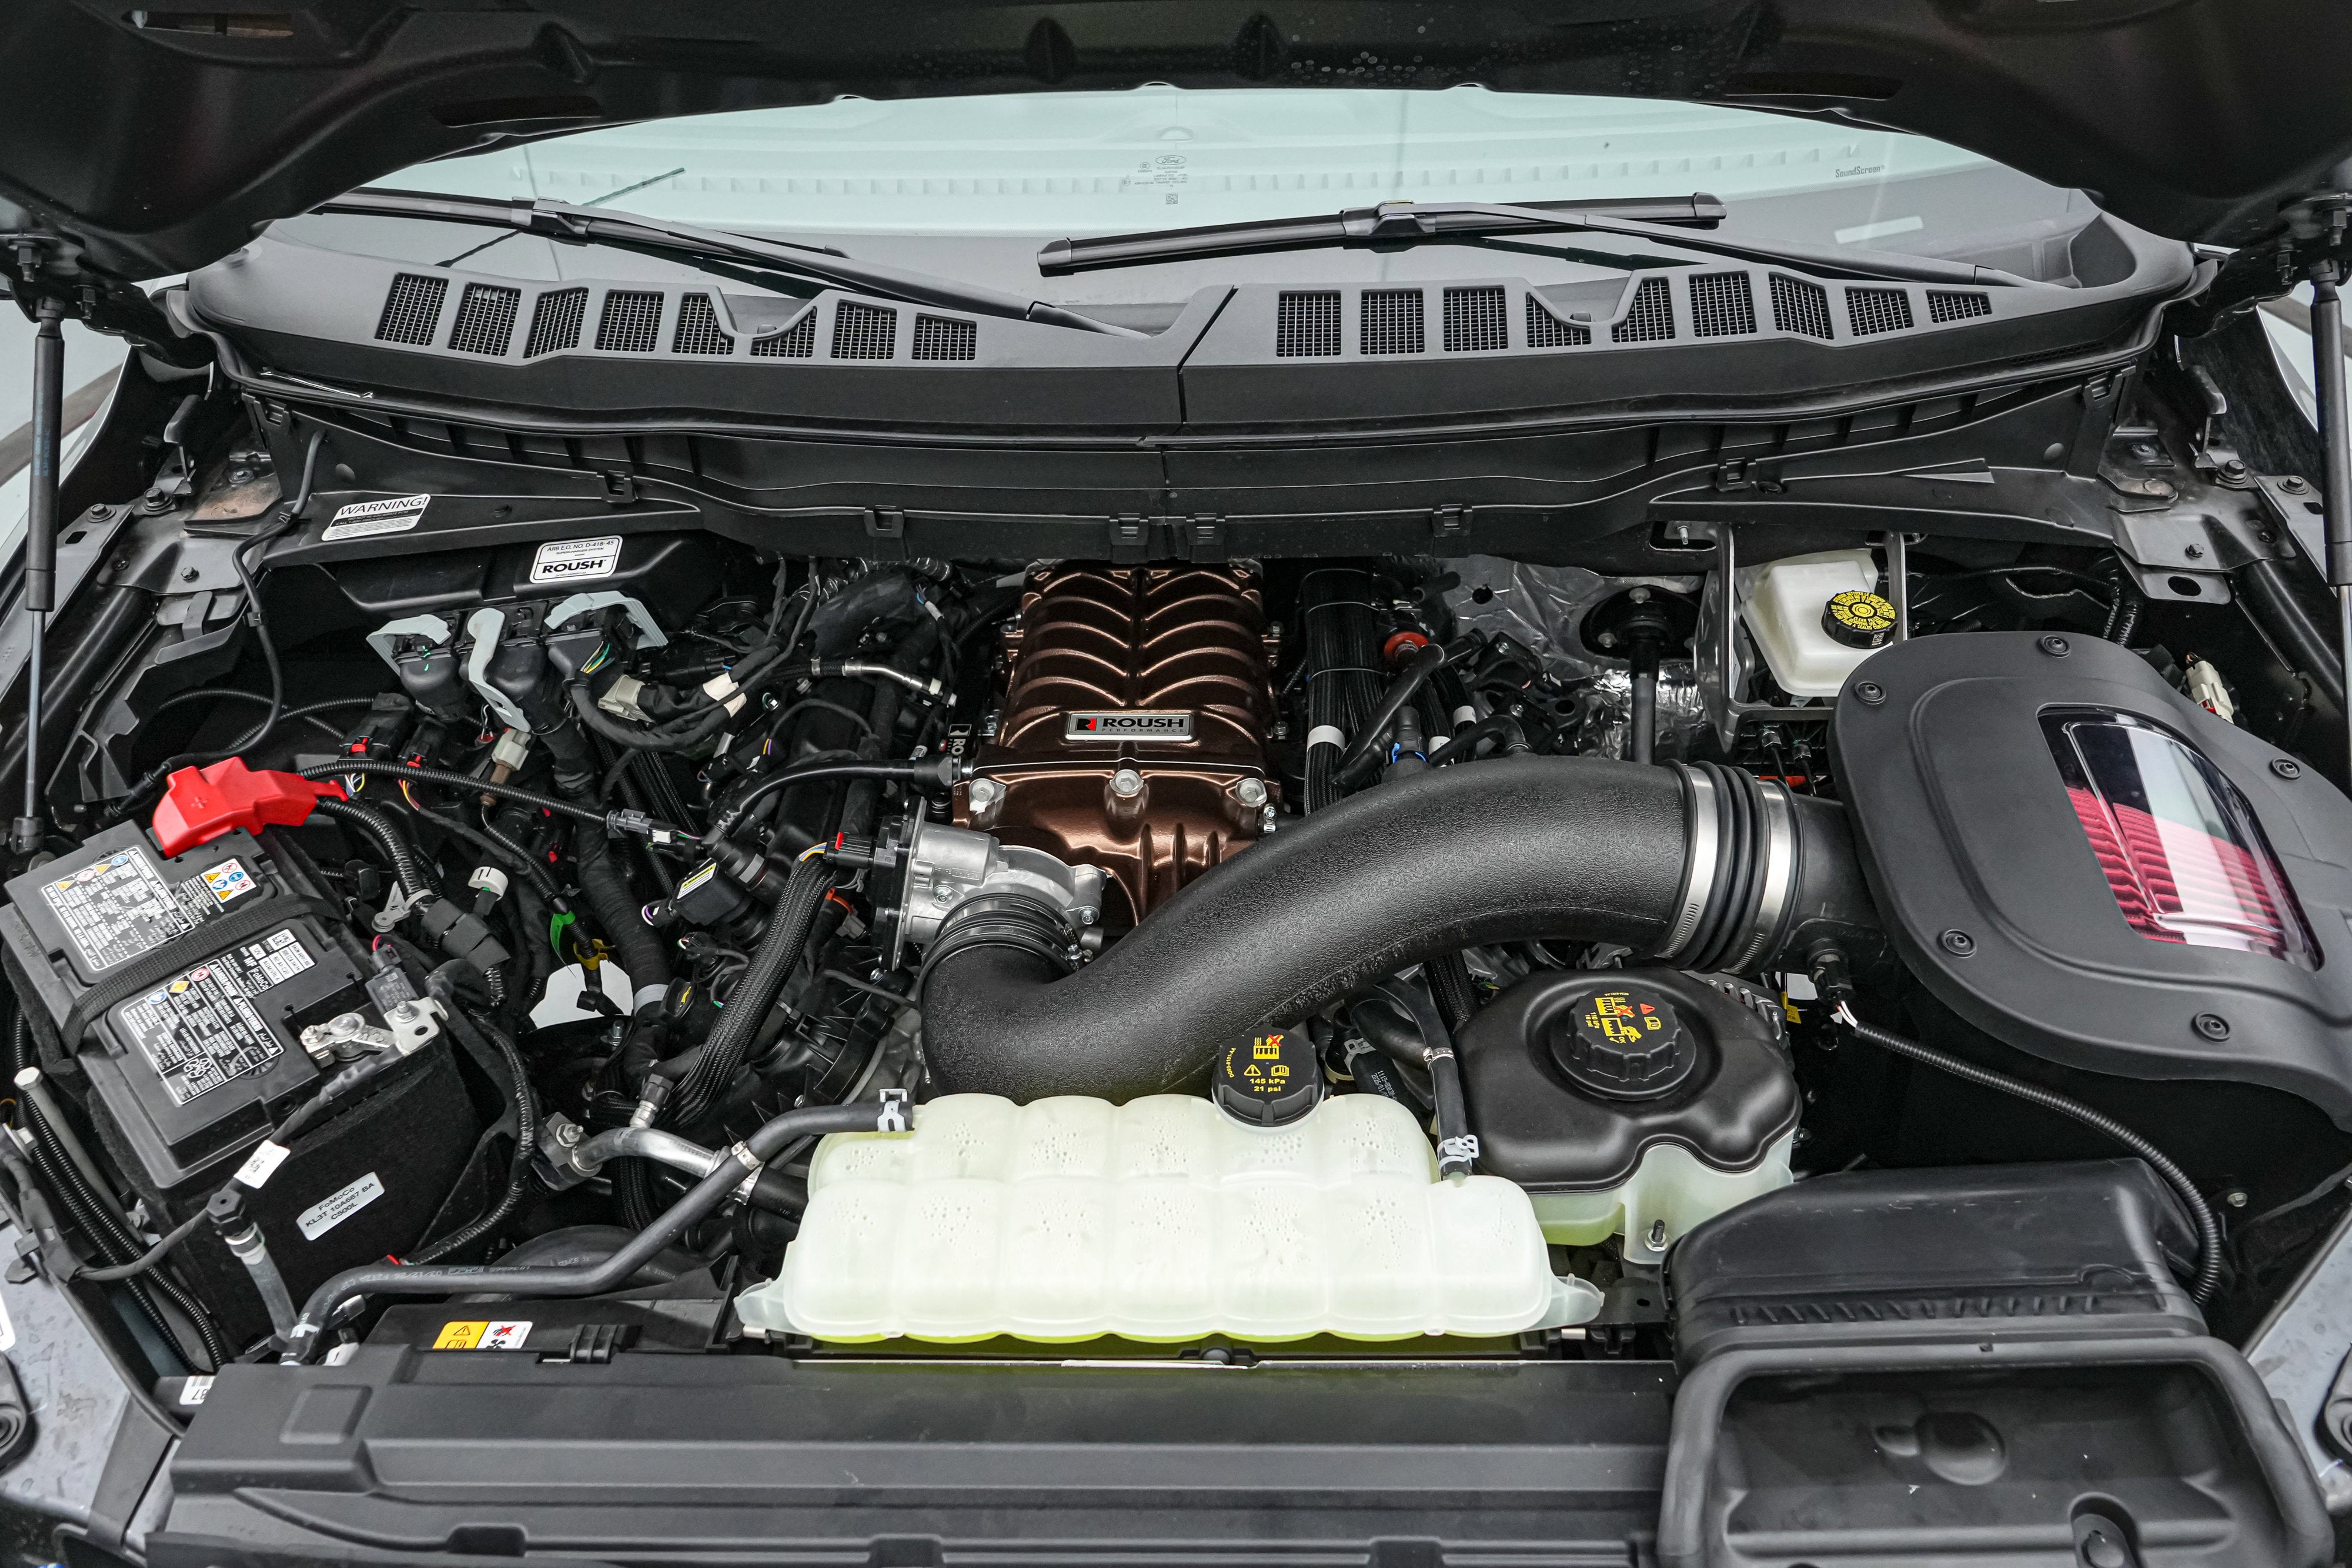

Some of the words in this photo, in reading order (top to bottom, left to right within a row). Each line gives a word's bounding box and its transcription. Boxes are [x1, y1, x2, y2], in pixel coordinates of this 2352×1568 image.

[1835, 166, 1880, 178] SoundScreen
[341, 497, 428, 516] WARNING!
[542, 560, 603, 574] ROUSH
[1102, 718, 1184, 727] ROUSH
[253, 947, 262, 956] 12V
[243, 955, 258, 969] MF
[281, 966, 290, 975] C20
[250, 968, 270, 991] FoMoCo
[306, 1211, 328, 1228] KL3T
[362, 1182, 375, 1193] BA
[319, 1187, 355, 1211] FoMoCo
[330, 1202, 358, 1220] C500L
